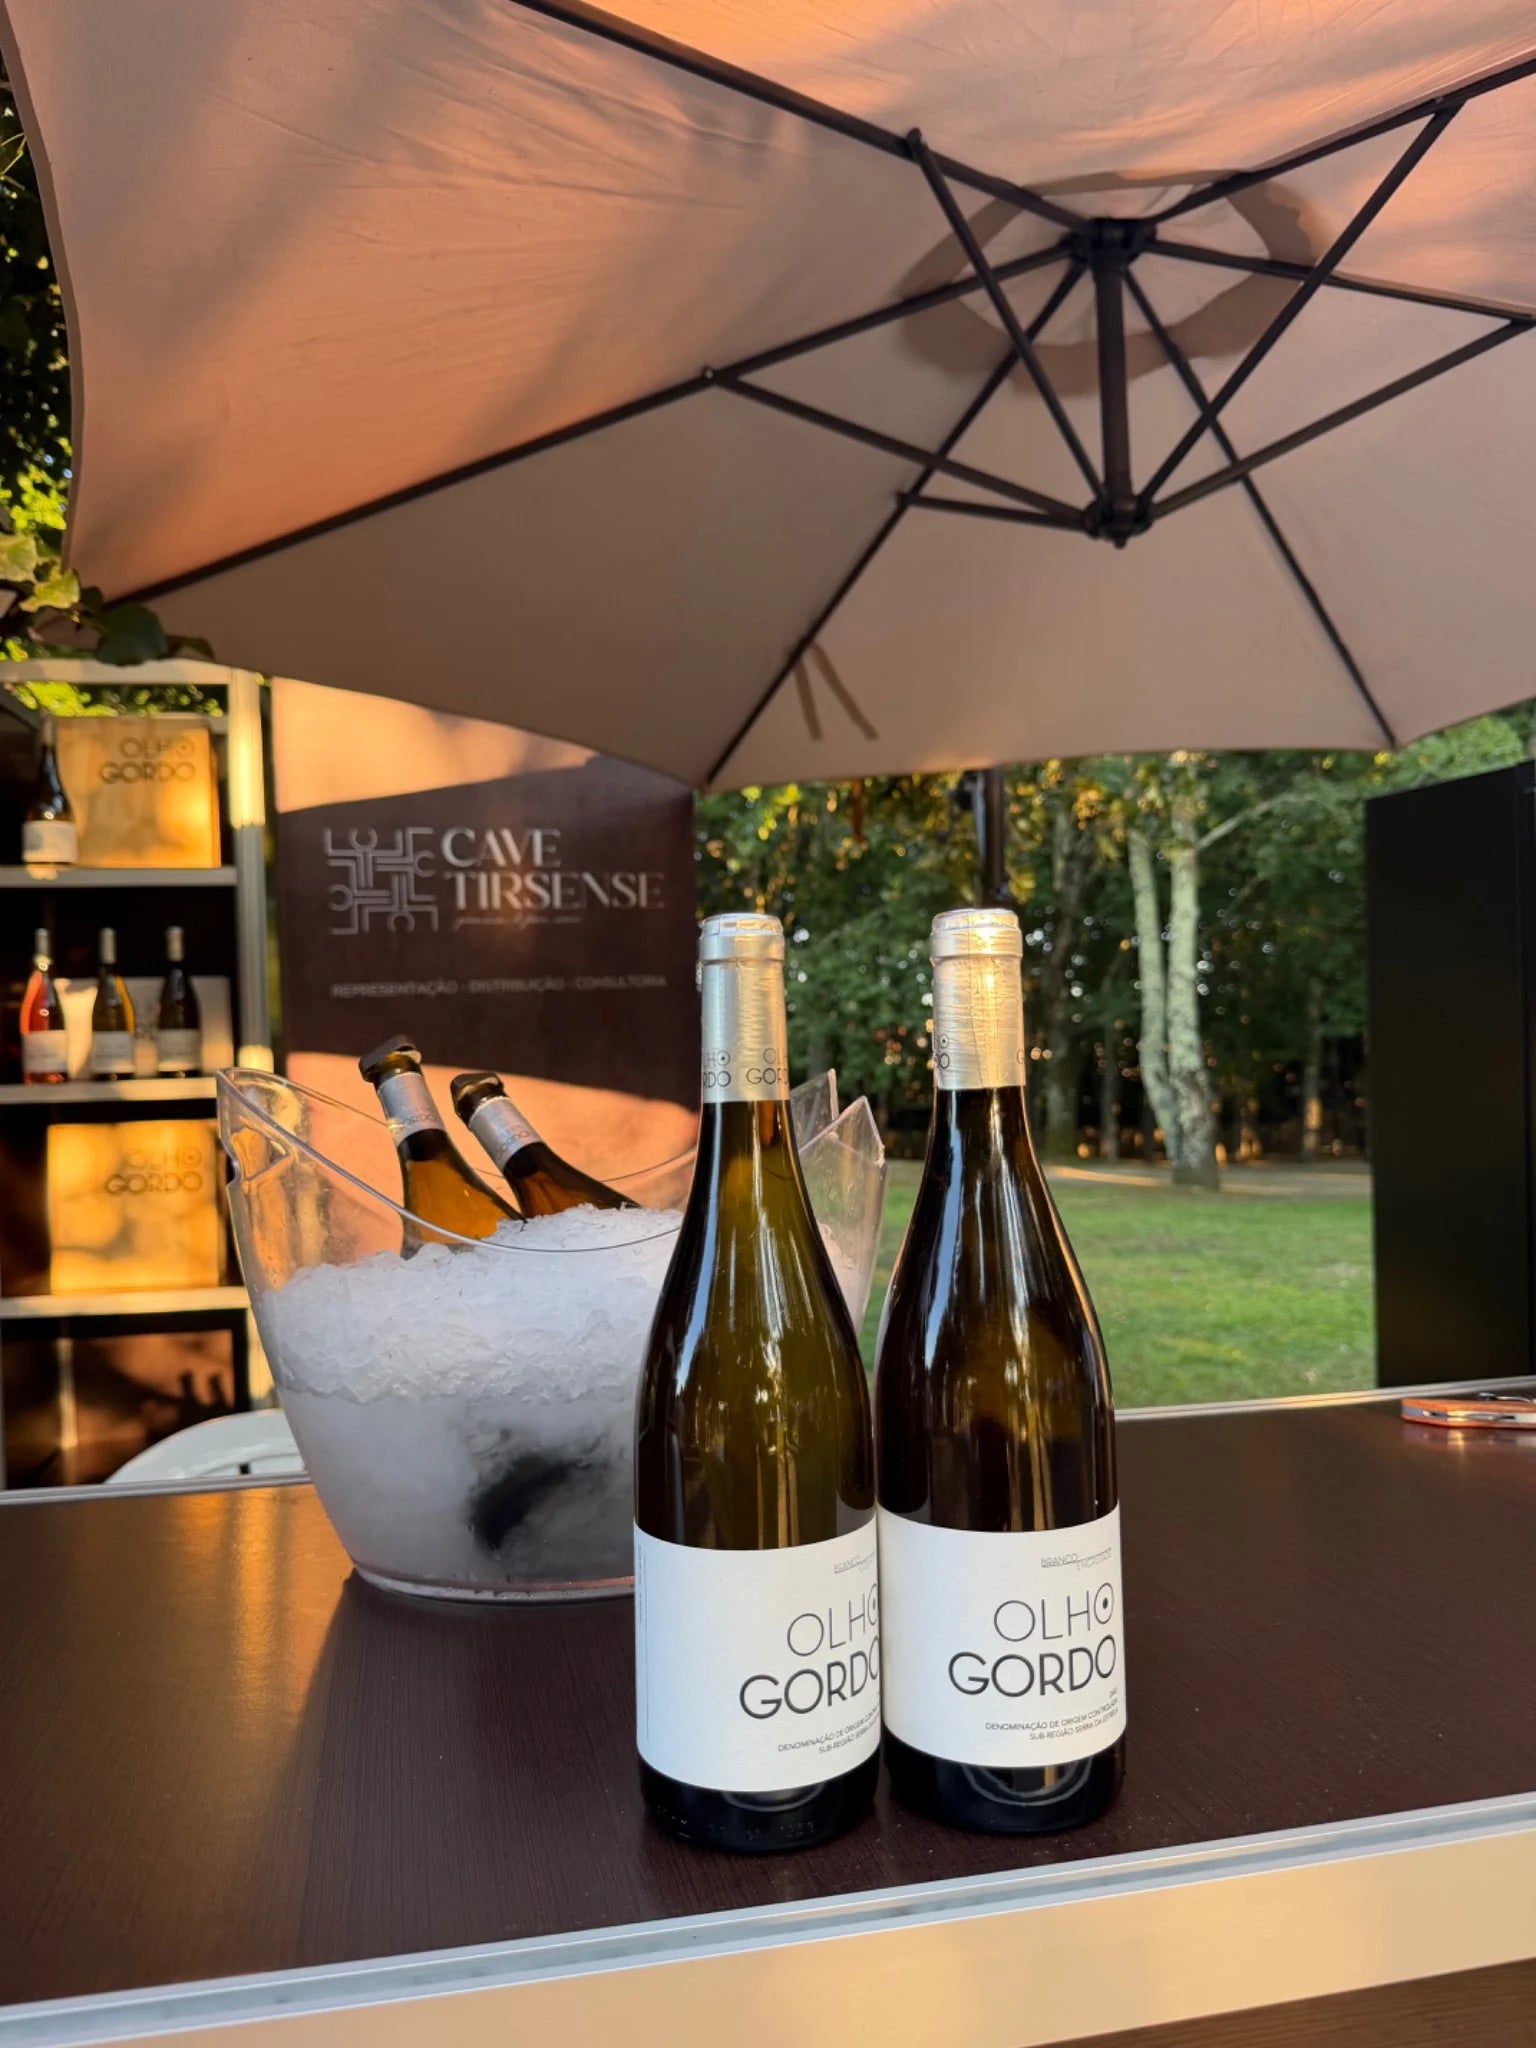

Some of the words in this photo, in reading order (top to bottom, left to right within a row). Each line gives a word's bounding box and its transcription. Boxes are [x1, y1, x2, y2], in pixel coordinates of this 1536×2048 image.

[120, 736, 195, 760] OLHO
[99, 761, 195, 784] GORDO
[440, 826, 561, 868] CAVE
[443, 872, 666, 912] TIRSENSE
[331, 977, 459, 999] REPRESENTAÇÃO
[469, 975, 565, 993] DISTRIBUIÇÃO
[104, 1171, 203, 1195] GORDO
[994, 1582, 1115, 1642] OLHO
[948, 1634, 1116, 1697] GORDO
[985, 1720, 1048, 1732] DENOMINAÇÃO
[1050, 1720, 1060, 1729] DE
[1061, 1713, 1087, 1727] ORIGEM
[1030, 1727, 1074, 1740] SUB-REGIÃO
[778, 1733, 834, 1752] DENOMINAÇÃO
